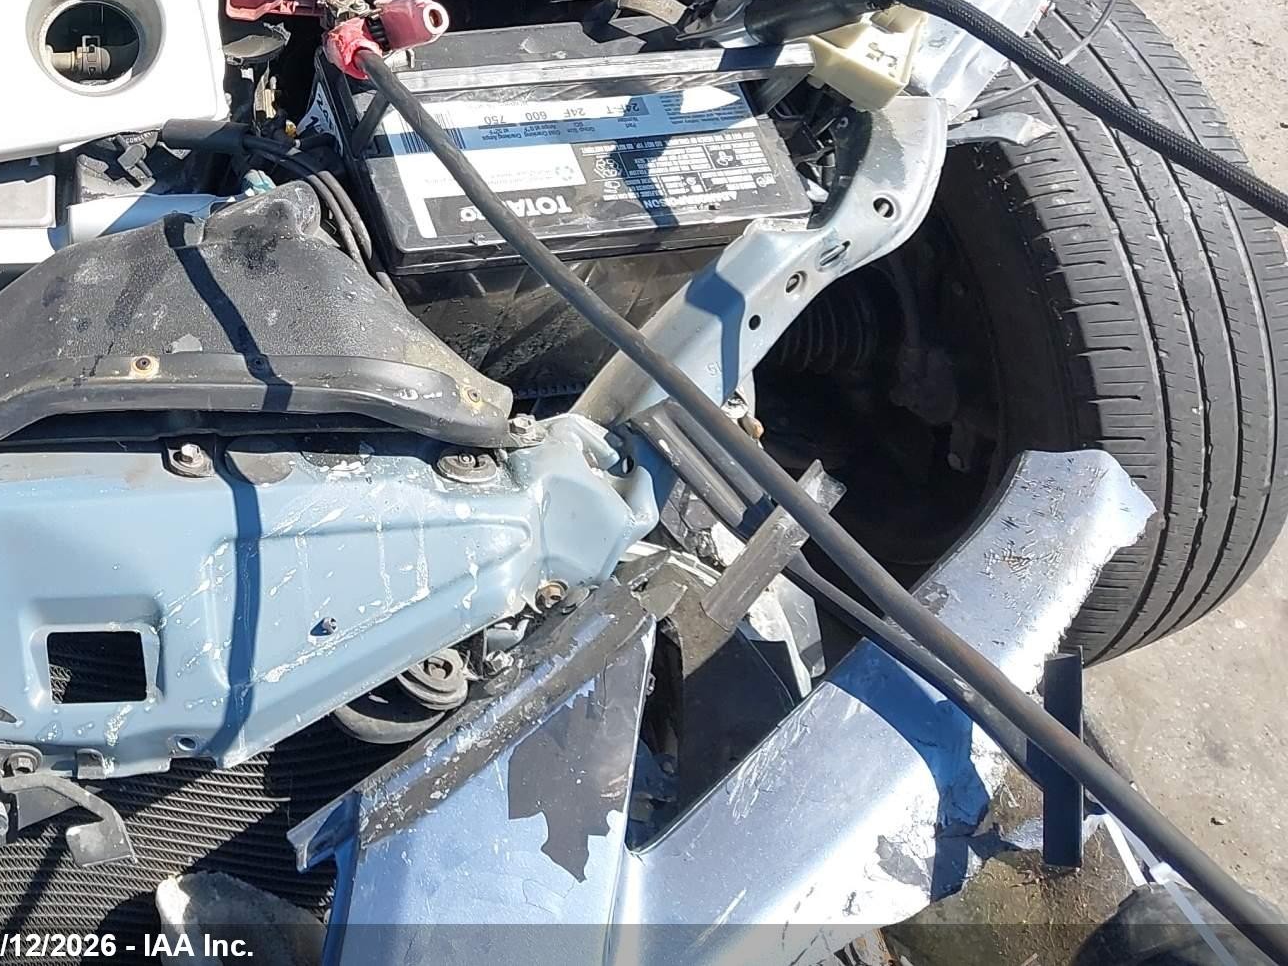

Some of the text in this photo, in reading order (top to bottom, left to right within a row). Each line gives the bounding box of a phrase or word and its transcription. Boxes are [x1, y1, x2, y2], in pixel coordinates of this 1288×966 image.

[525, 110, 548, 122] 600
[563, 107, 587, 118] 24F
[484, 115, 507, 125] 750
